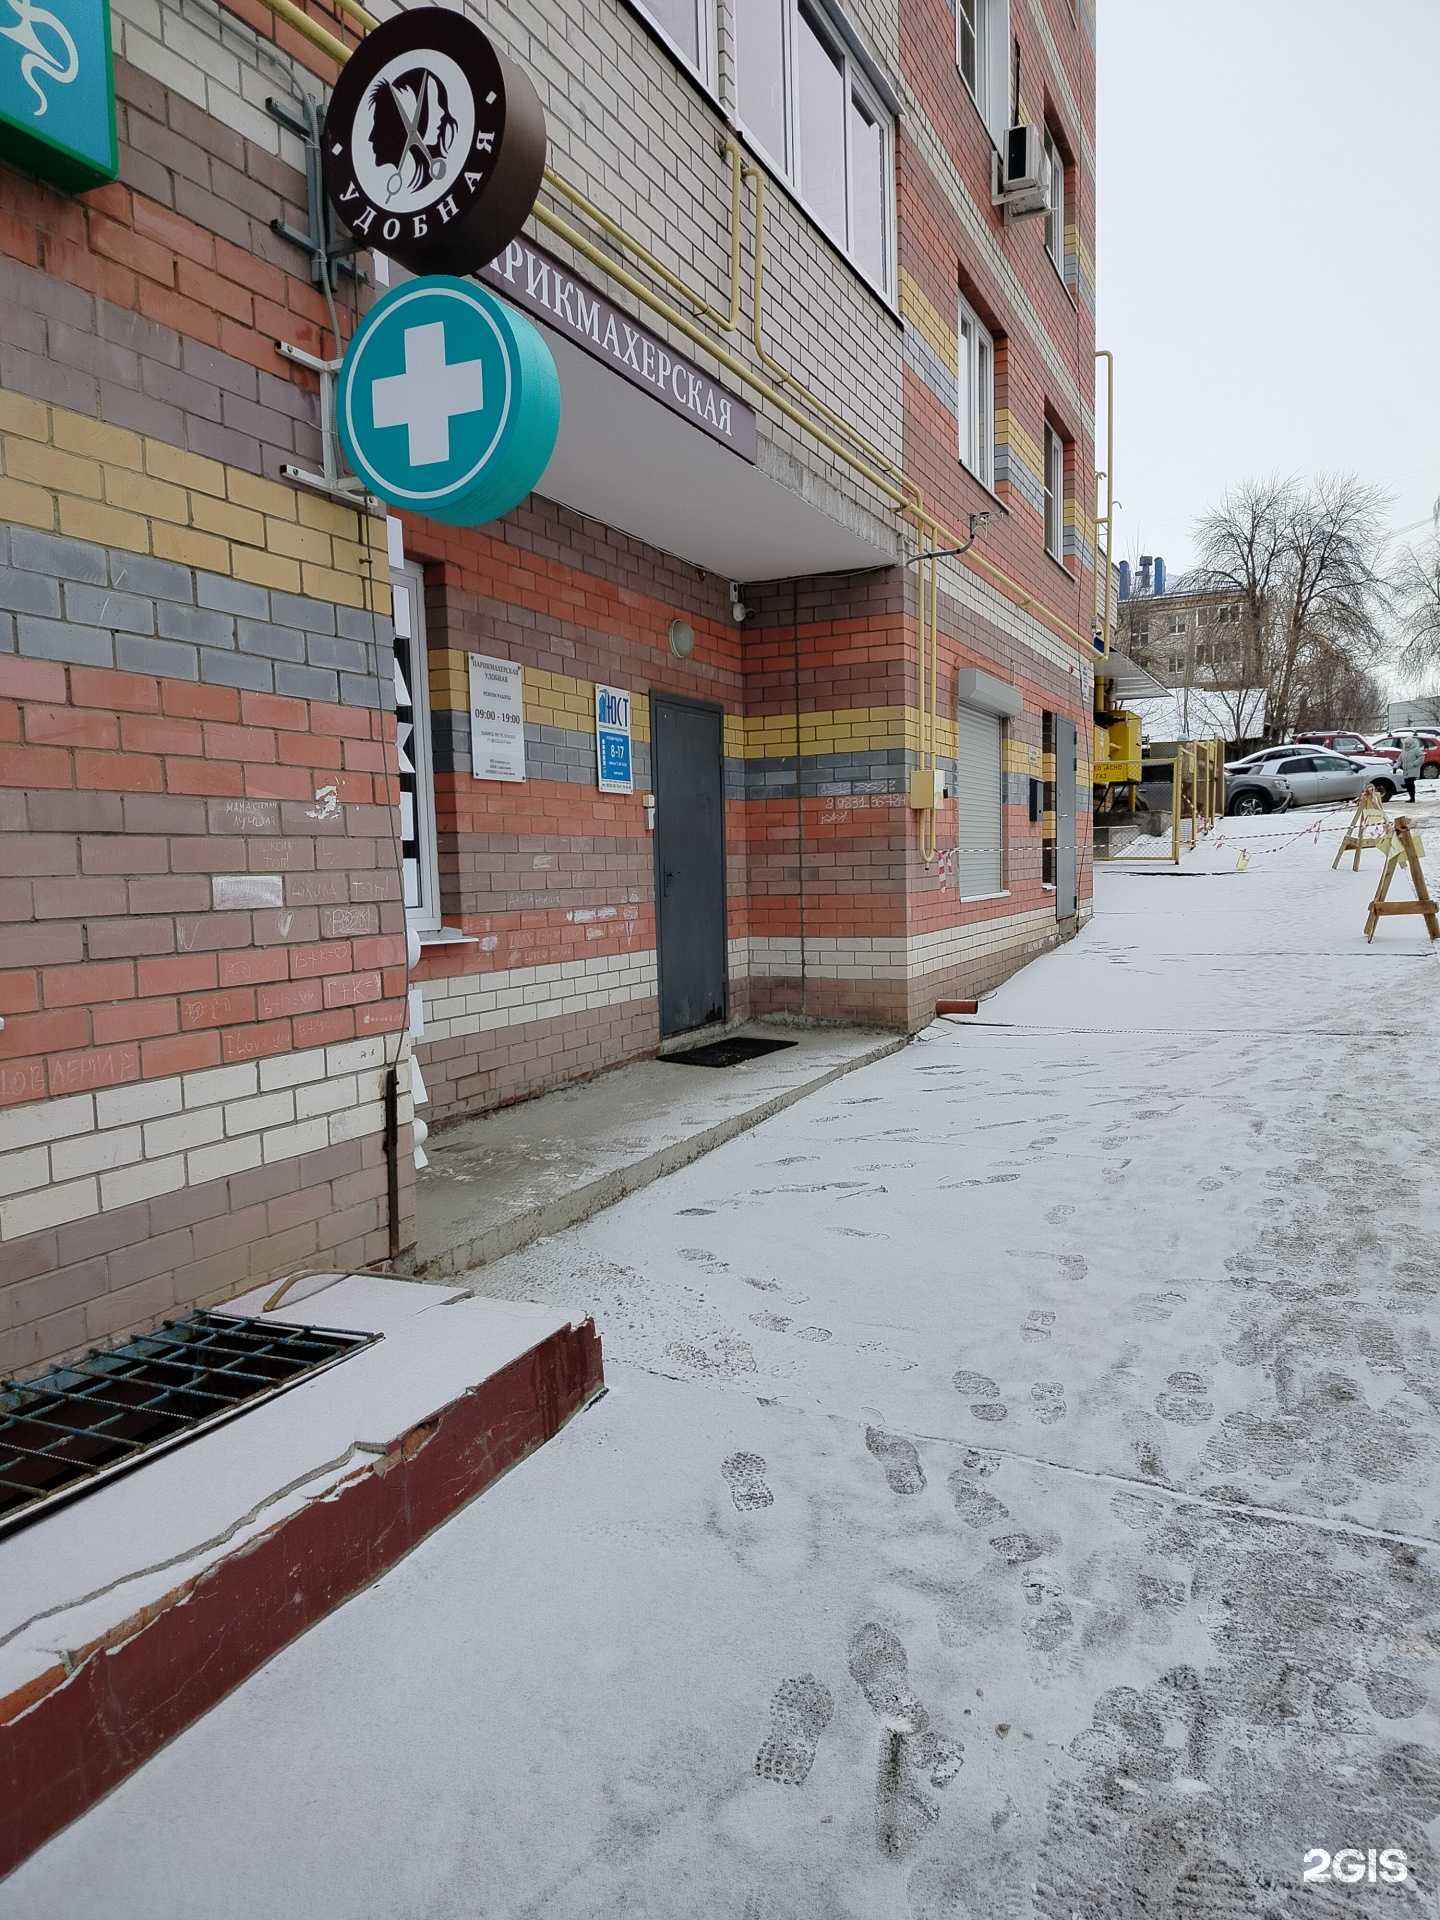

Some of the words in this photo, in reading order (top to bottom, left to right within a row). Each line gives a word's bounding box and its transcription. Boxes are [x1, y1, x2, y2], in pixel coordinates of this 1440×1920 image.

[339, 130, 495, 239] УДОБНАЯ
[489, 240, 732, 436] РИКМАХЕРСКАЯ
[475, 708, 495, 721] 09:00
[502, 712, 520, 724] 19:00
[610, 744, 624, 760] 8-17
